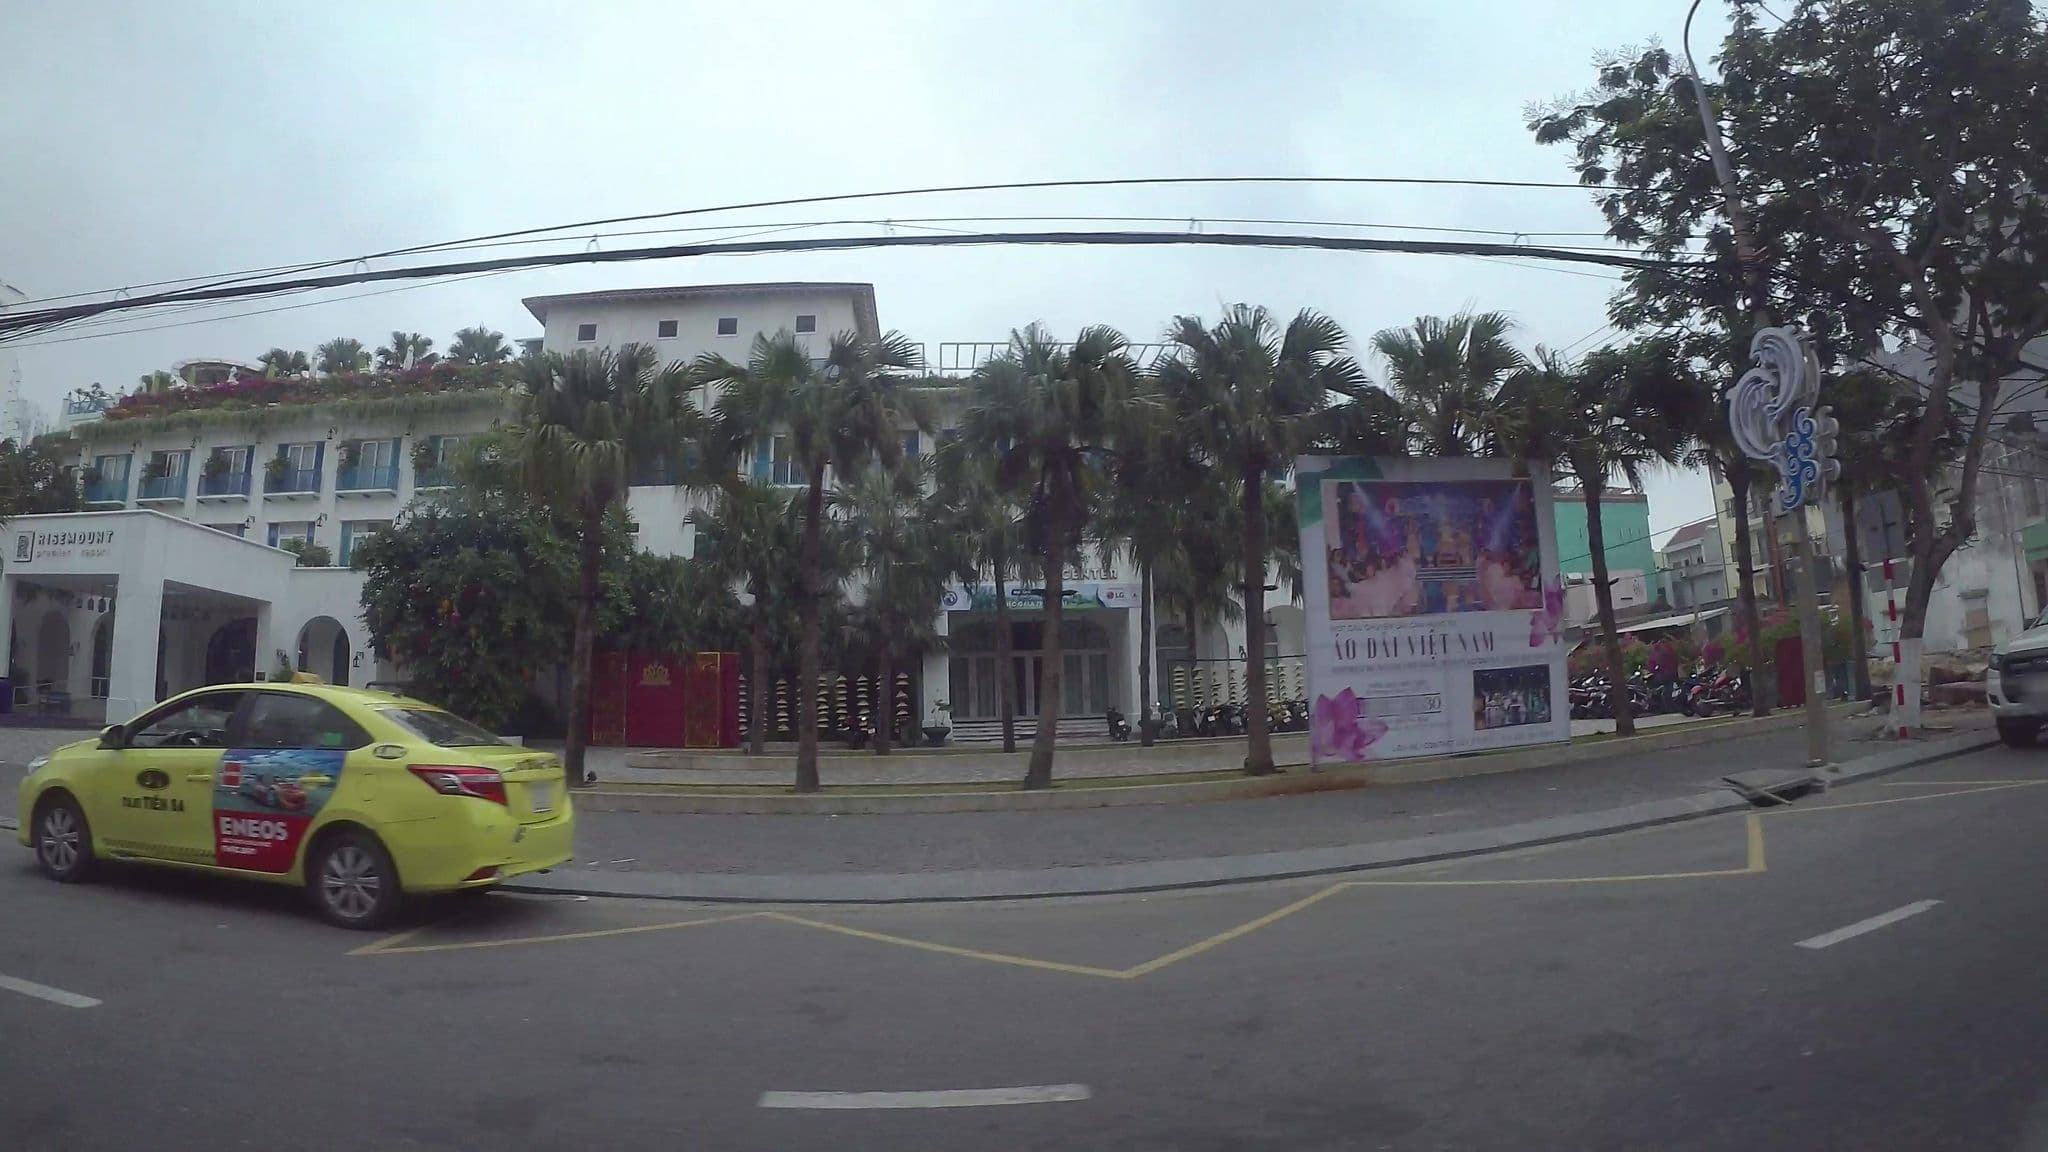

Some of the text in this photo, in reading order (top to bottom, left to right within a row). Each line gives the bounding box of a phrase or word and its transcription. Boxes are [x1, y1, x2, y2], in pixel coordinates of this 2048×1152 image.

[38, 530, 114, 546] RISEMOUNT
[1062, 566, 1118, 580] CENTER
[219, 816, 289, 841] ENEOS
